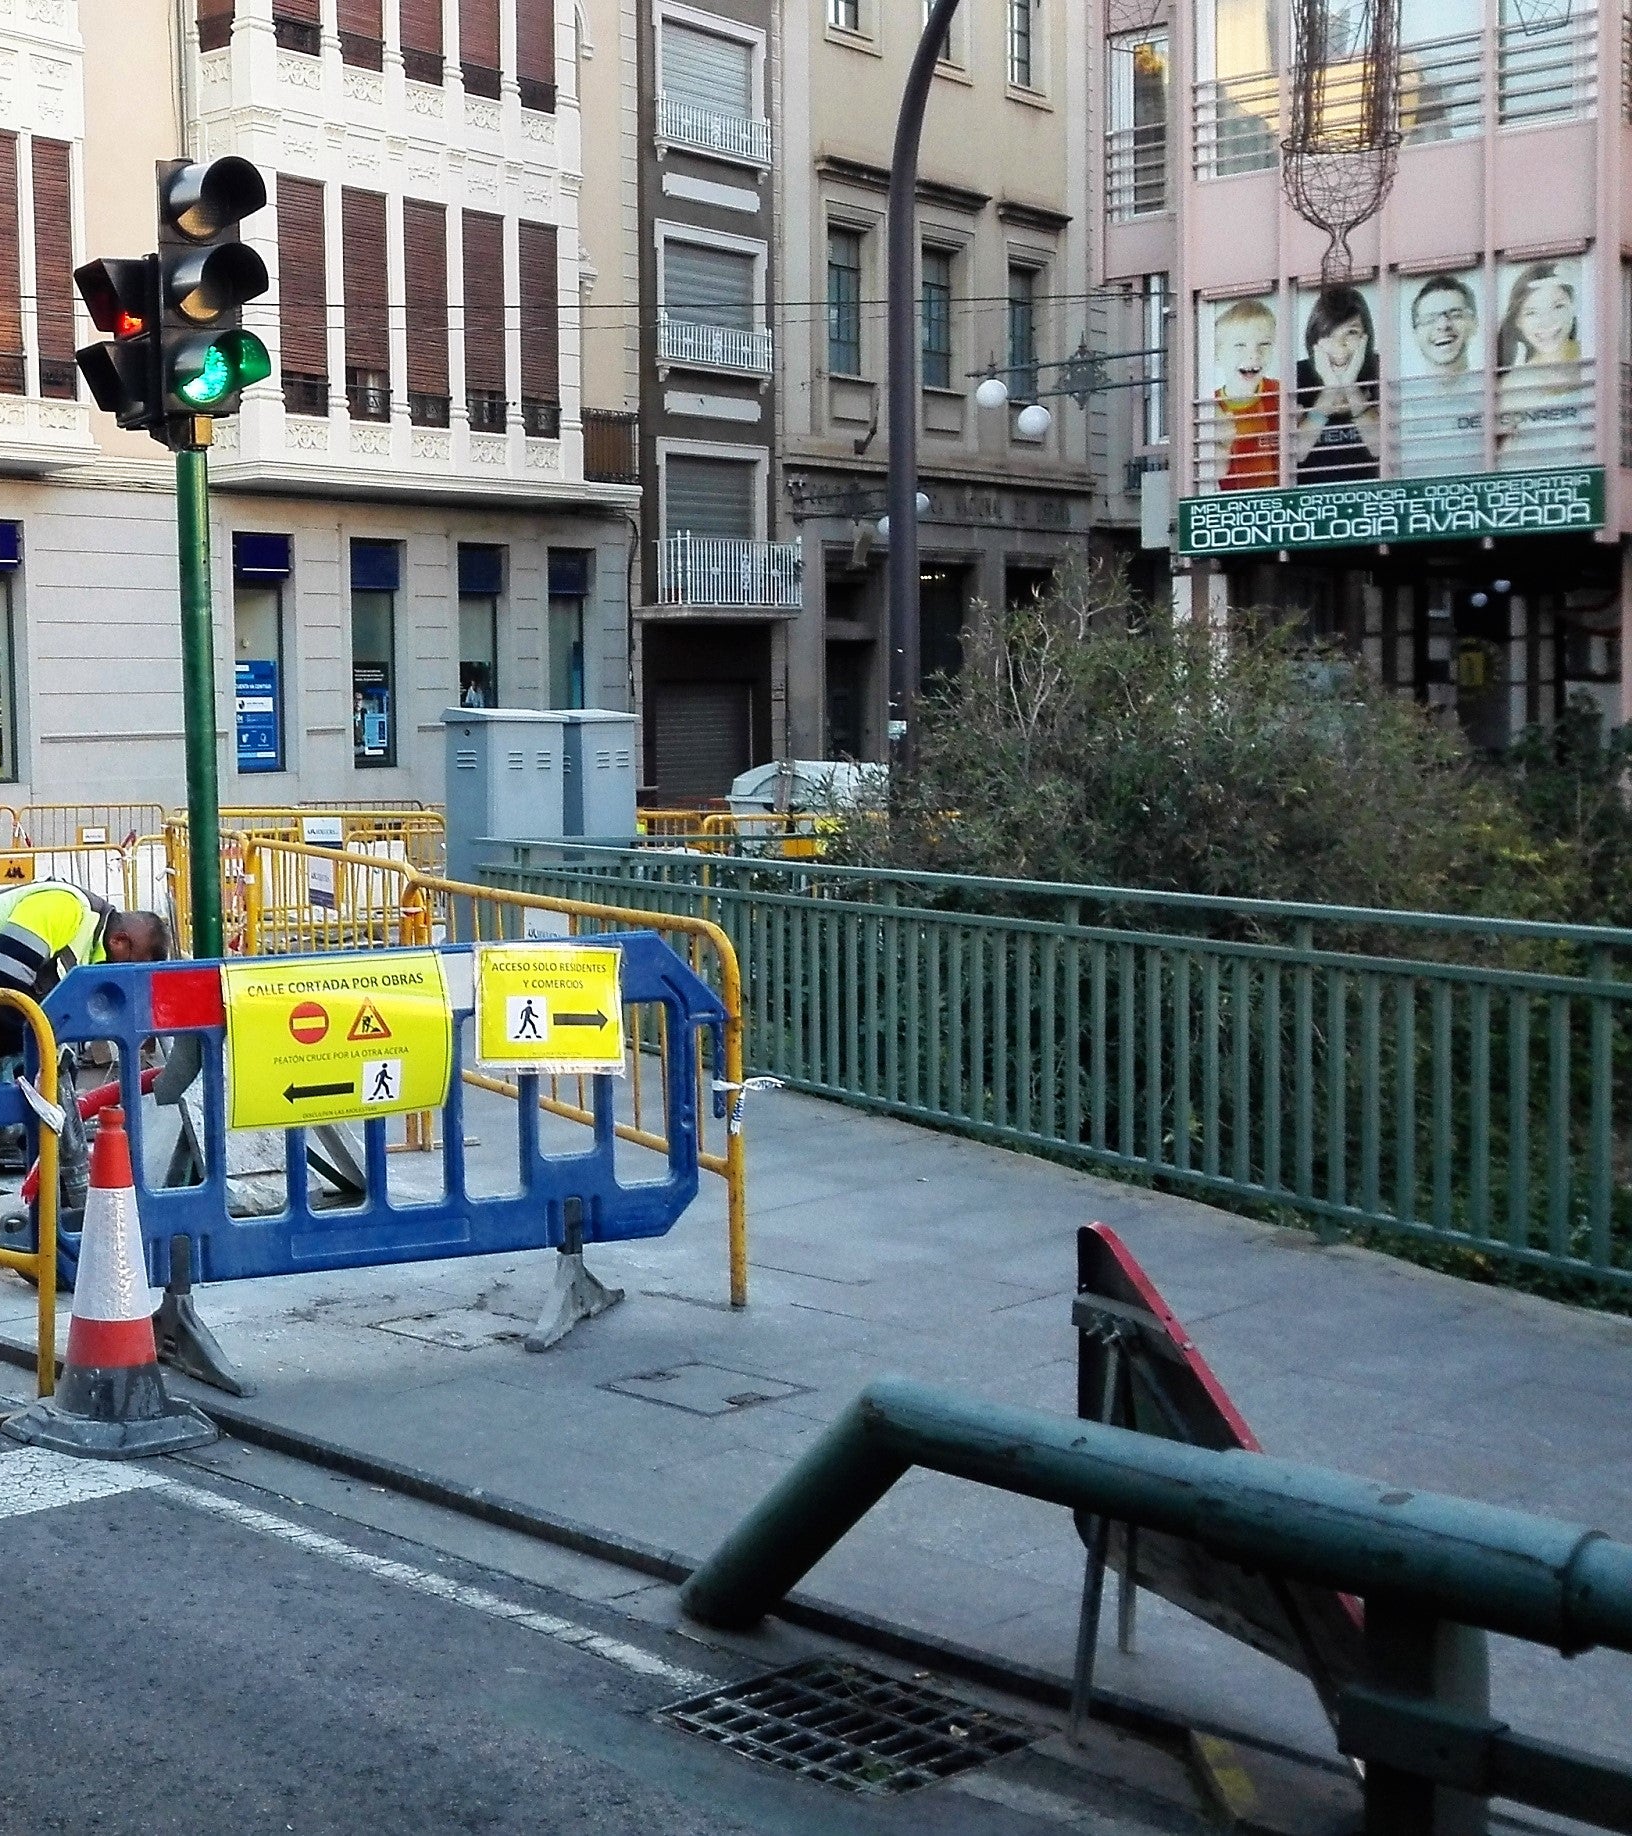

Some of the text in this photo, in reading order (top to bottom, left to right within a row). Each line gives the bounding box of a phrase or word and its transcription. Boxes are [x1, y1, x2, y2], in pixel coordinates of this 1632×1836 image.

[1190, 474, 1591, 516] IMPLANTES ORTODONCIA ODONTOPEDIATRIA
[1190, 487, 1590, 530] PERIODONCIA ESTETICA DENTAL
[1191, 502, 1591, 549] ODONTOLOGIA AVANZADA
[491, 962, 607, 973] ACCESO SOLO RESIDENTES
[247, 972, 424, 997] CALLE CORTADA POR OBRAS
[523, 979, 584, 989] Y COMERCIOS
[273, 1046, 409, 1065] PEATÓN CRUCE POR LA OTRA ACERA
